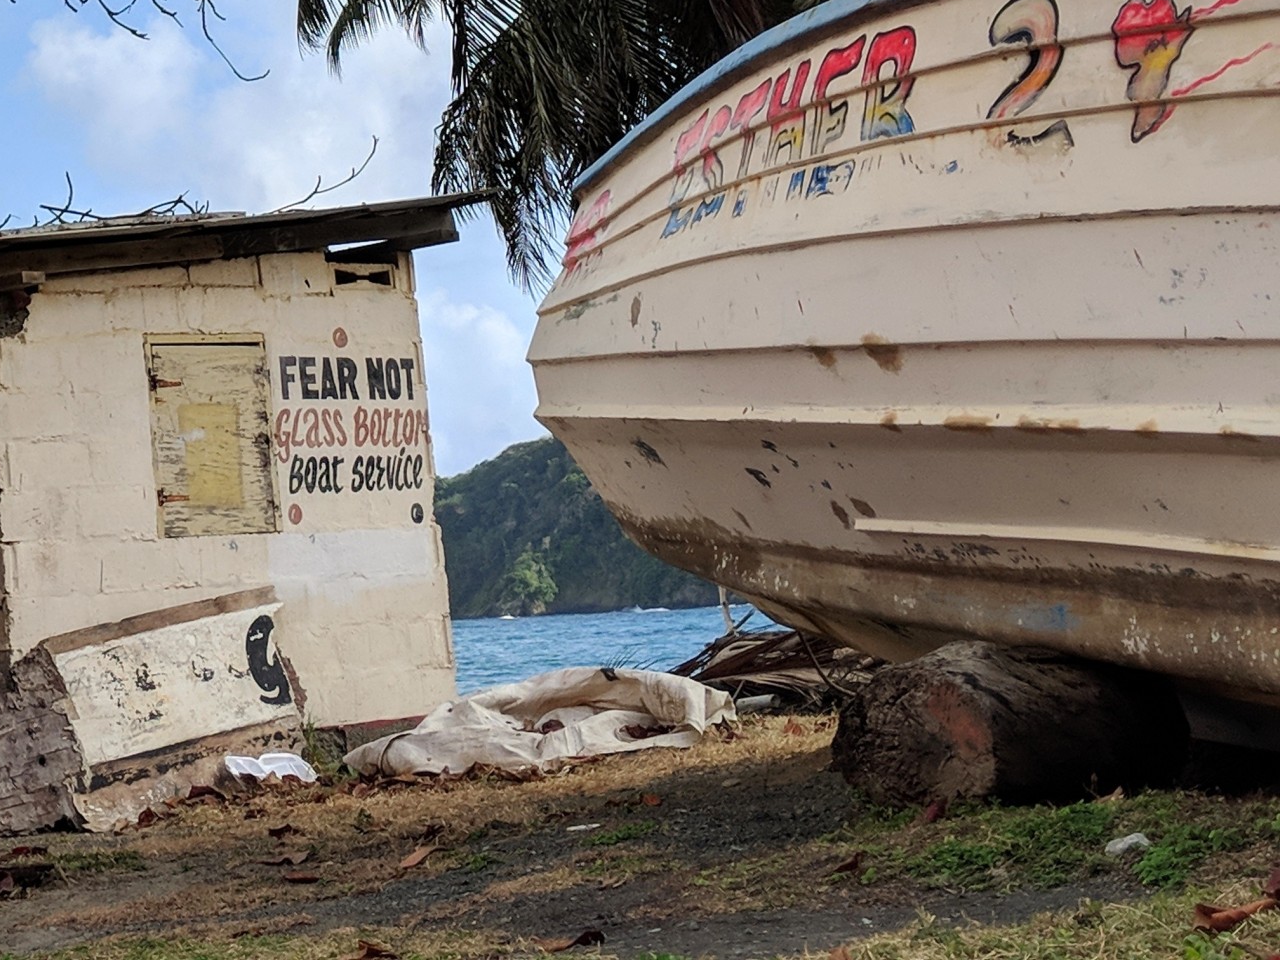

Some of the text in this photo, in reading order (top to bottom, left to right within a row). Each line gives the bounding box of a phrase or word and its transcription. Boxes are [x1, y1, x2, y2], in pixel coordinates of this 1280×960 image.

[278, 355, 415, 401] FEAR NOT
[289, 453, 345, 495] Boat
